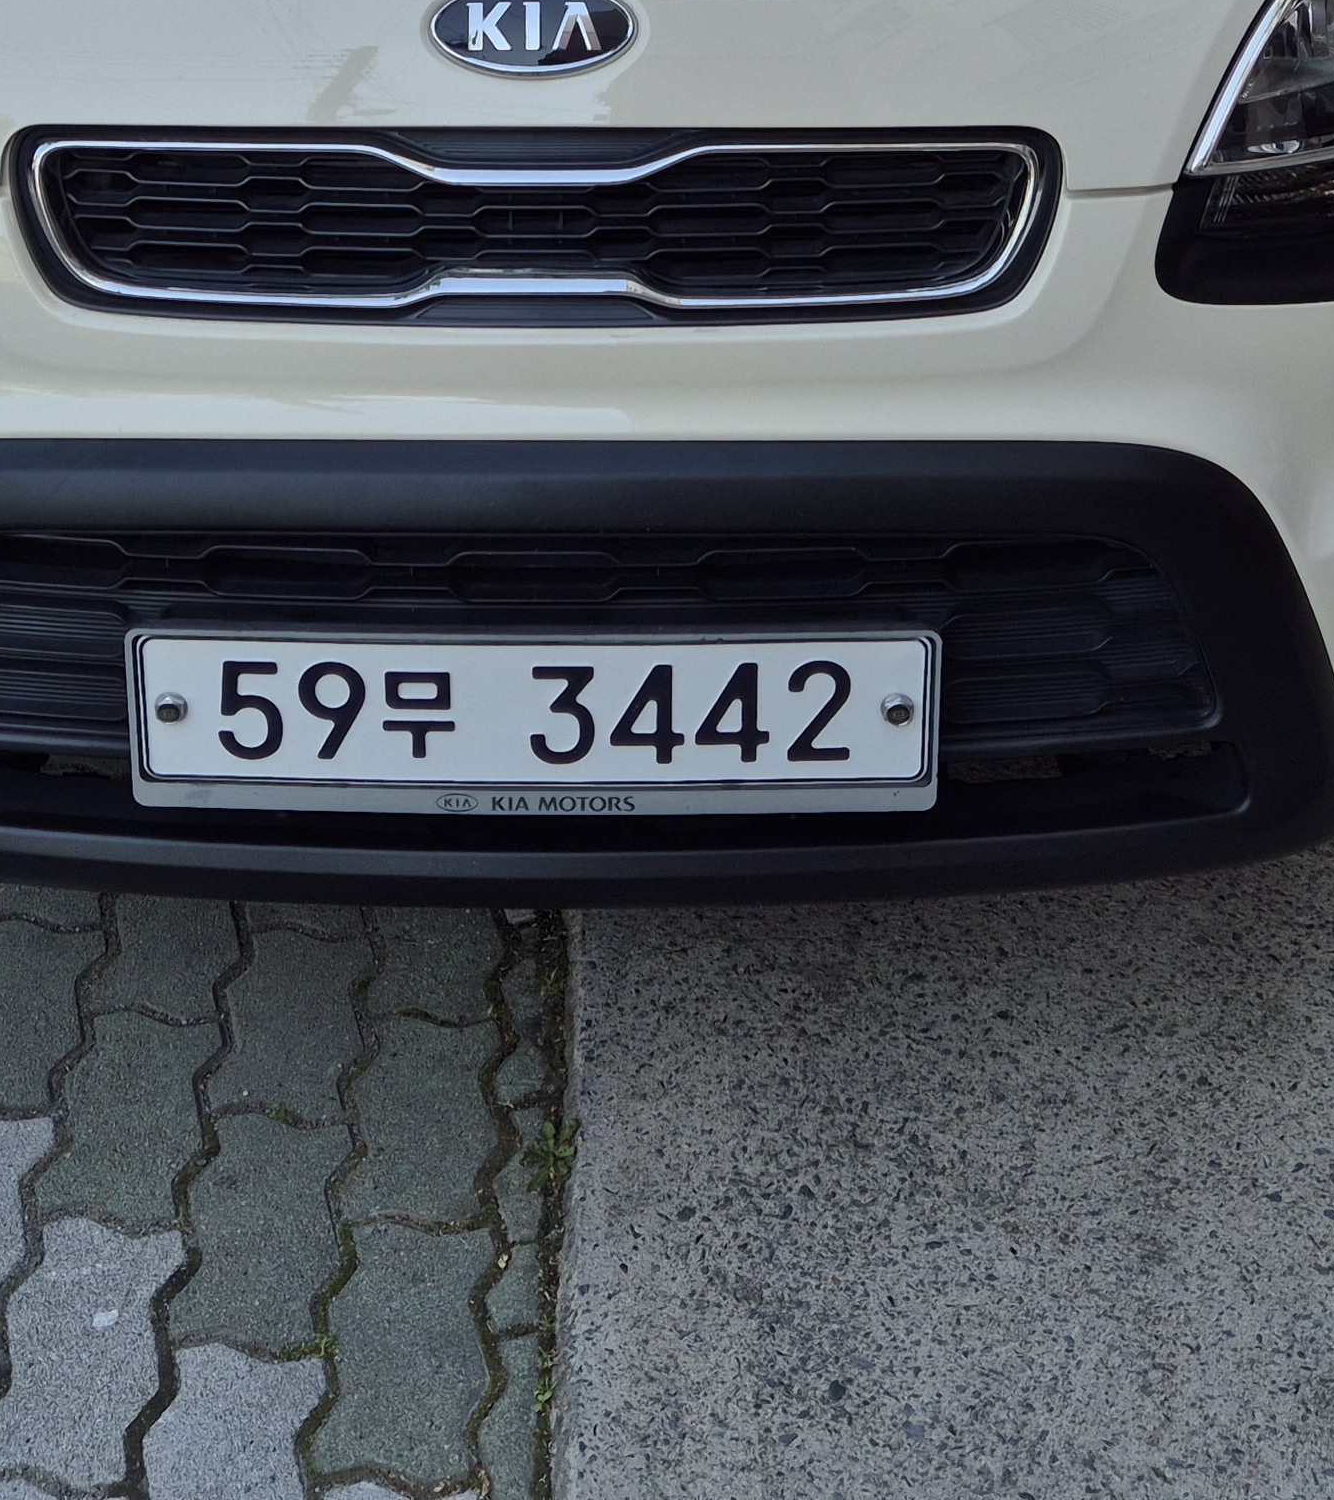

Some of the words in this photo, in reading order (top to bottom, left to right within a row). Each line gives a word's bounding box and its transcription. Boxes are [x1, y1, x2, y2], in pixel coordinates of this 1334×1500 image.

[466, 1, 603, 51] KIA
[218, 660, 456, 760] 59무
[530, 660, 851, 764] 3442
[443, 798, 472, 808] KIA
[491, 796, 530, 812] KIA
[538, 796, 636, 812] MOTORS
